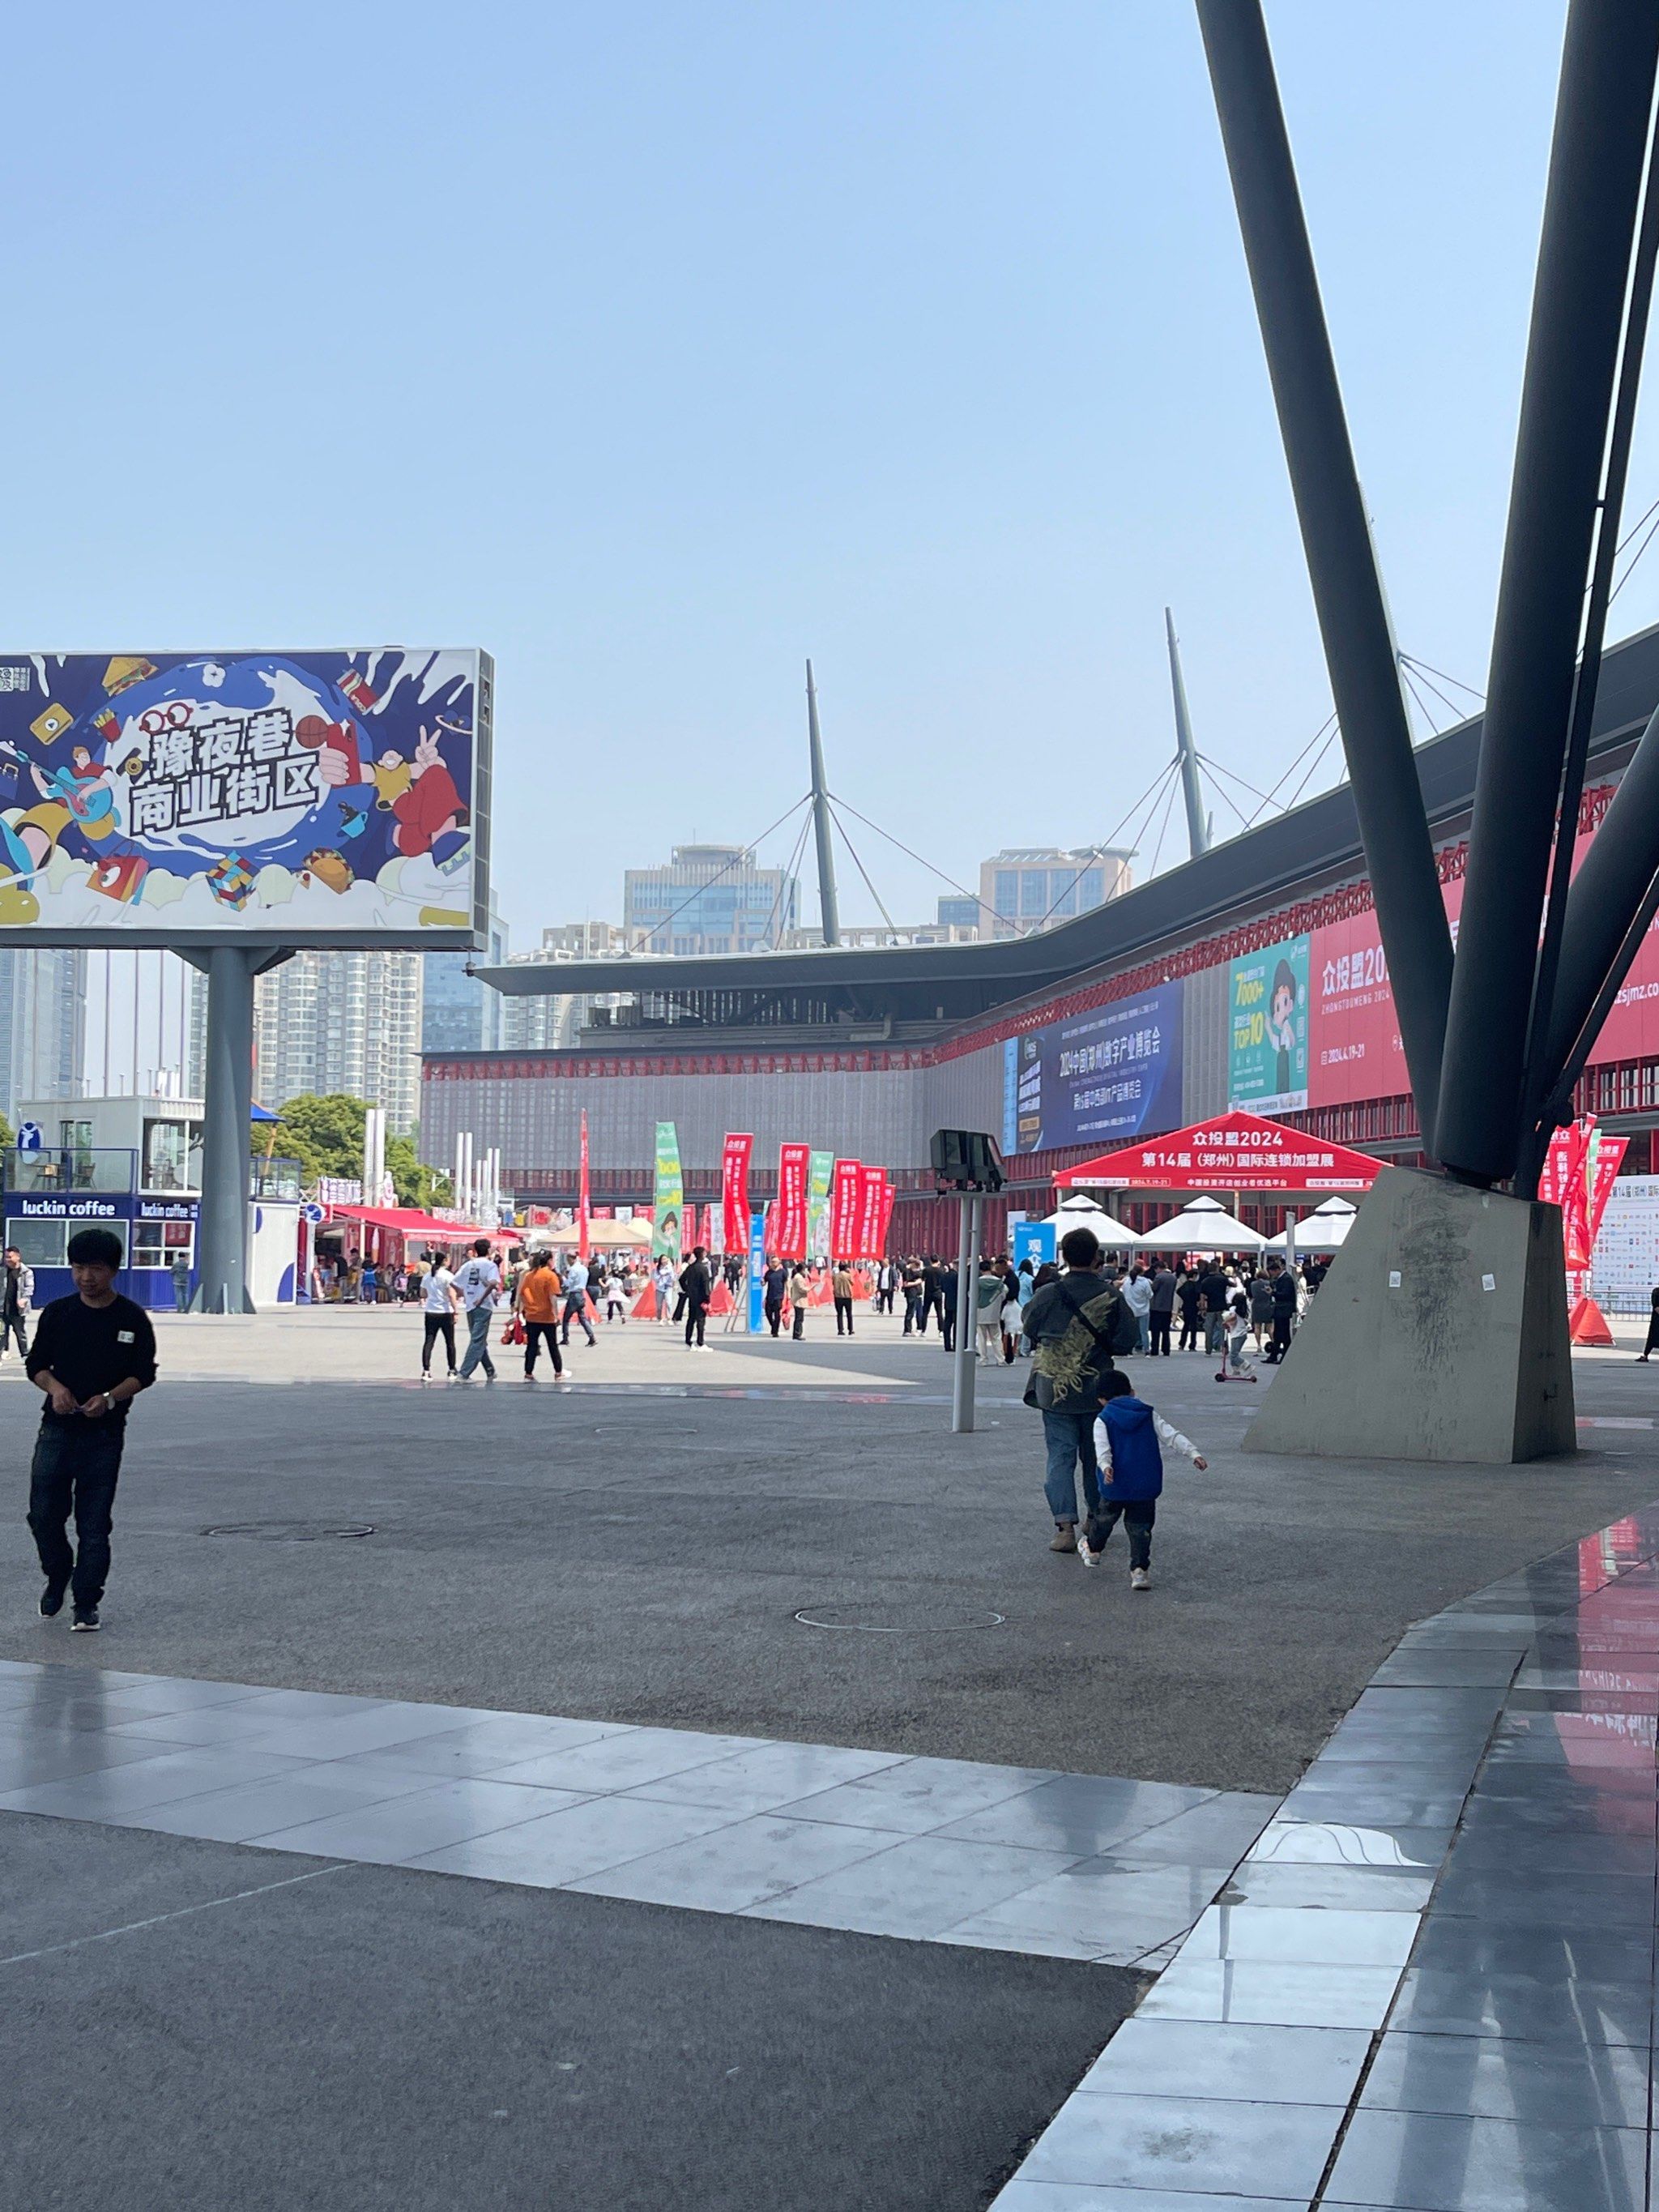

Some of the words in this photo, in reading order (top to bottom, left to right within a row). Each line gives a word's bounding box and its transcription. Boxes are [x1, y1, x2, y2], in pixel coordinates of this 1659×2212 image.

[151, 711, 291, 779] 豫夜巷
[132, 754, 318, 834] 商业街区
[1322, 945, 1389, 997] 众投盟20
[1192, 1131, 1284, 1147] 众投盟2024
[23, 1200, 66, 1215] luckin
[69, 1200, 116, 1215] coffee
[141, 1202, 164, 1217] luckin
[165, 1203, 189, 1218] coffee
